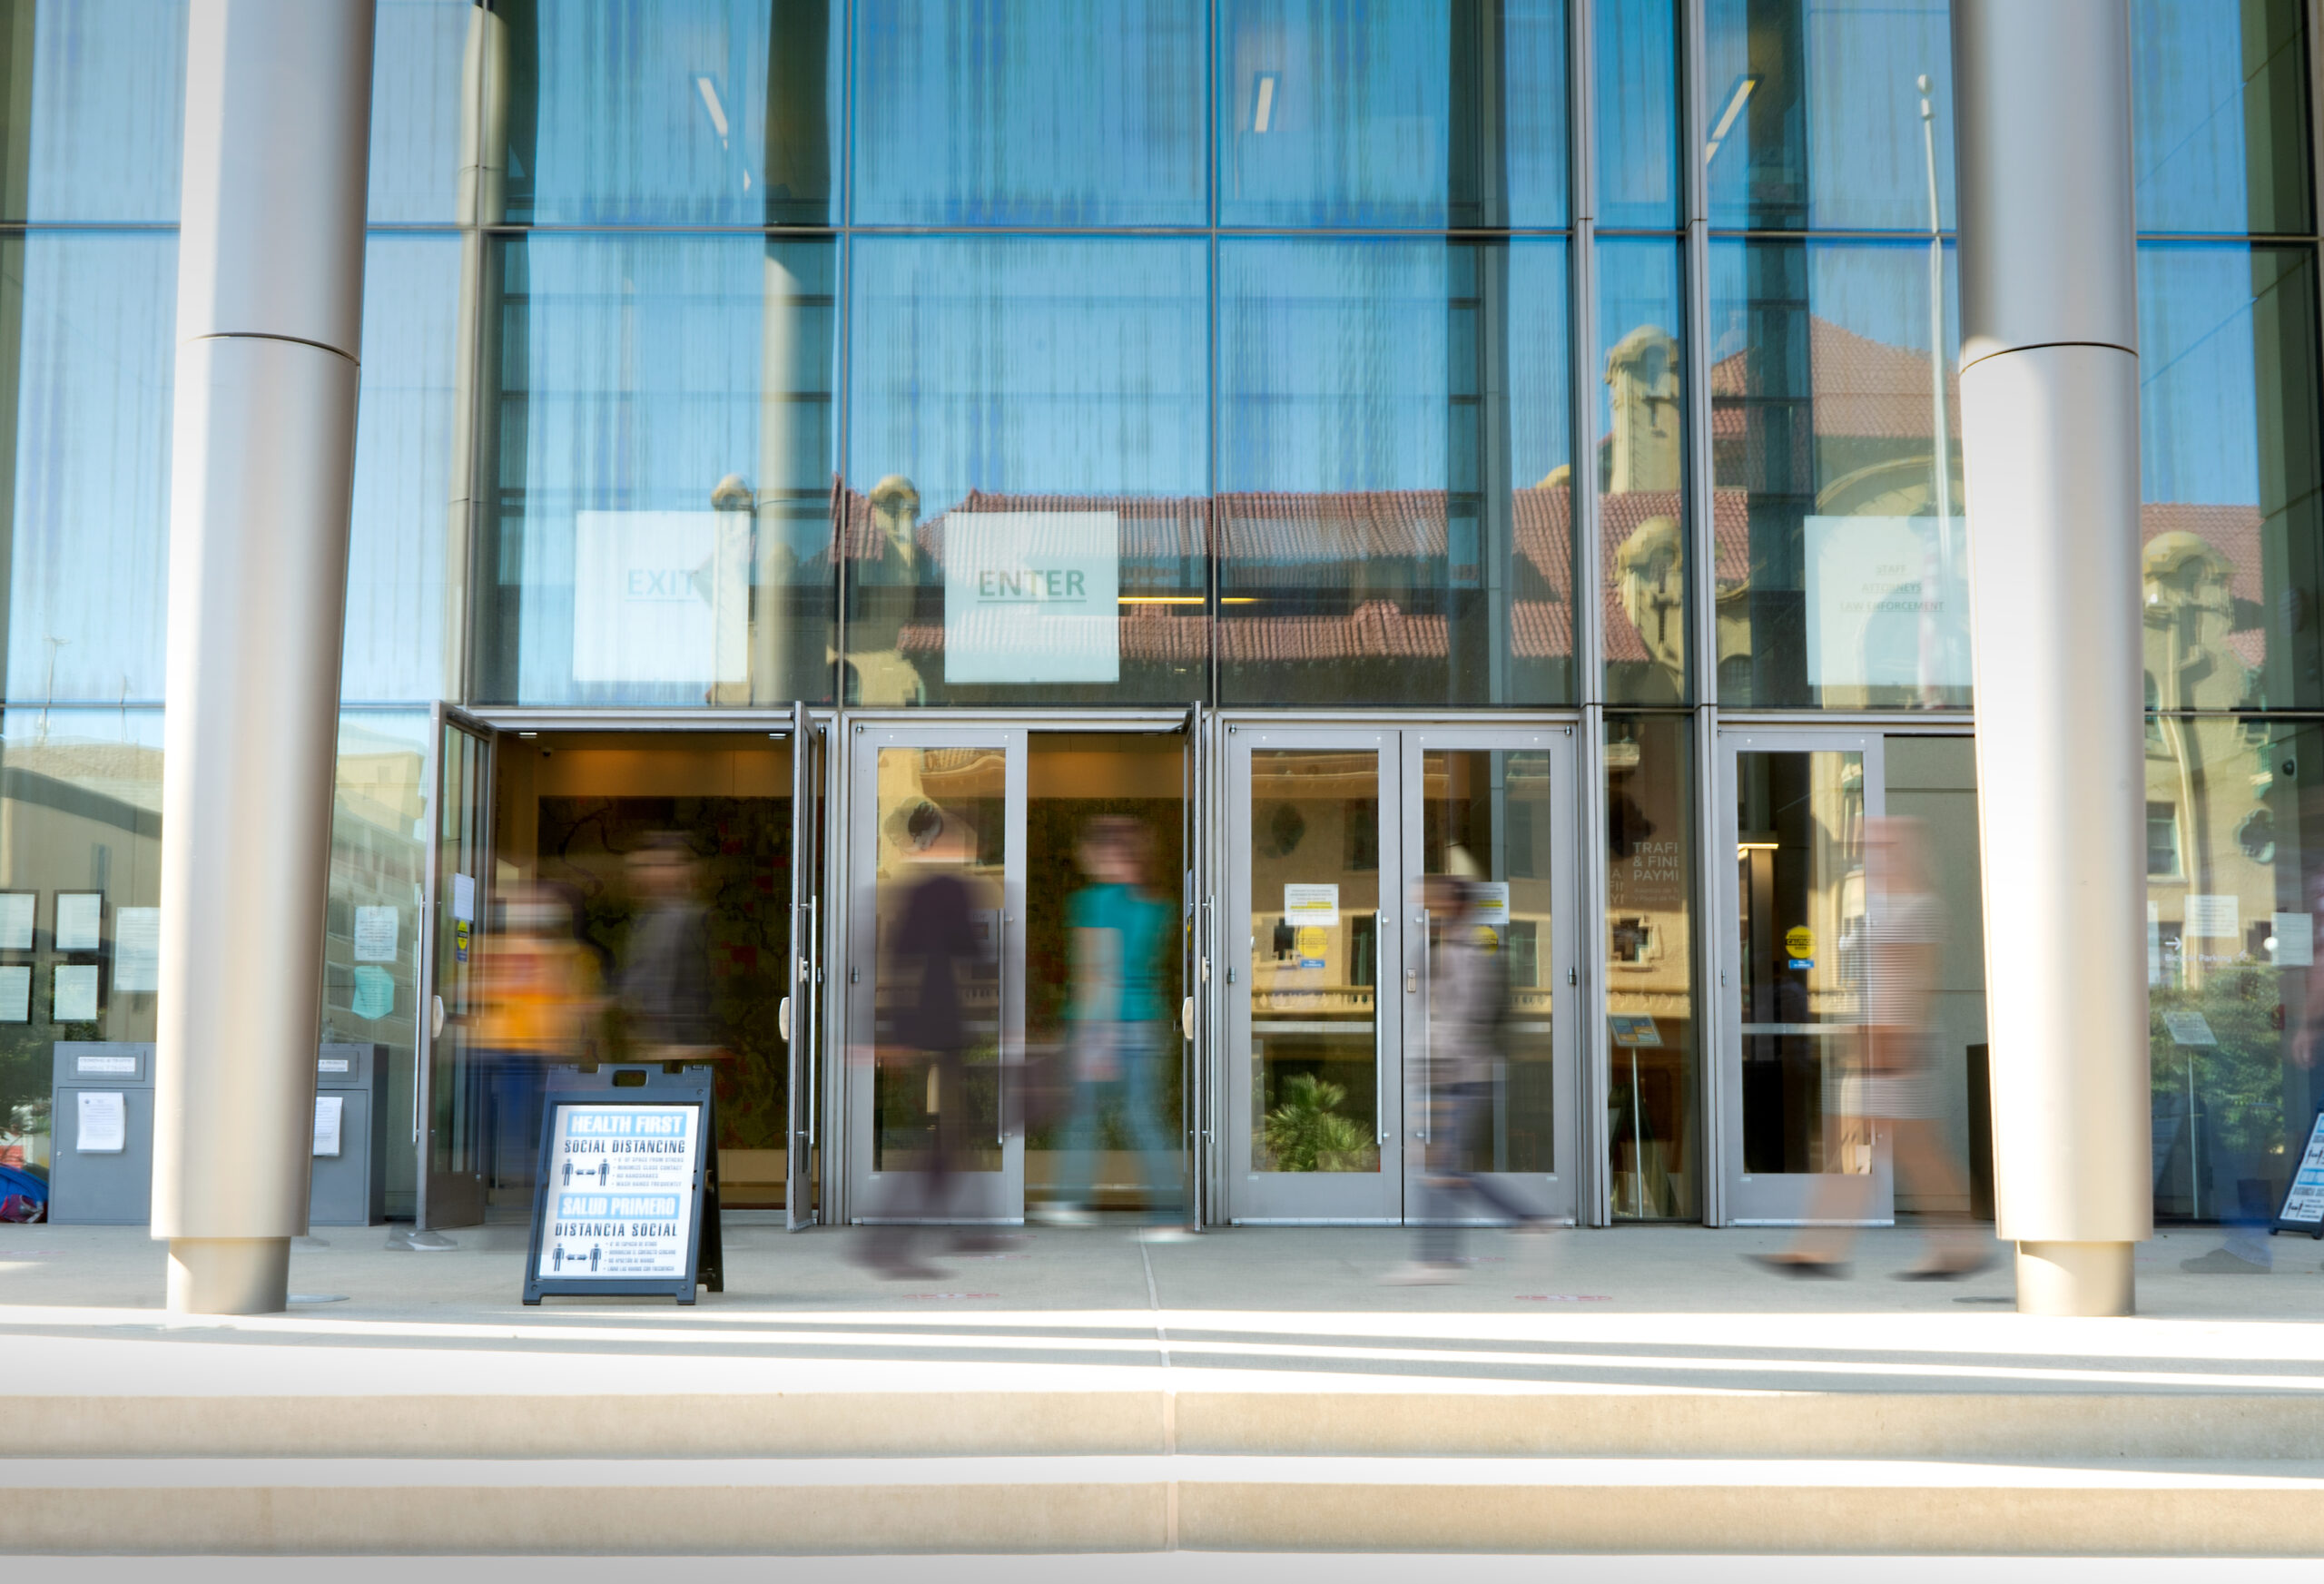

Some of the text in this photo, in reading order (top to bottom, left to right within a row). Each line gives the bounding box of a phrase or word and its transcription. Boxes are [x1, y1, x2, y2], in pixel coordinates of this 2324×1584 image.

[1876, 565, 1905, 574] STAFF
[626, 568, 698, 596] EXIT
[979, 569, 1088, 596] ENTER
[1861, 583, 1923, 593] ATTORNEYS
[1866, 601, 1945, 611] ENFORCEMENT
[1633, 855, 1642, 867] &
[2199, 953, 2232, 963] Parking
[571, 1116, 684, 1134] HEALTH FIRST
[565, 1139, 685, 1154] SOCIAL DISTANCING
[562, 1196, 675, 1215] SALUD PRIMERO
[555, 1223, 677, 1236] DISTANCIA SOCIAL
